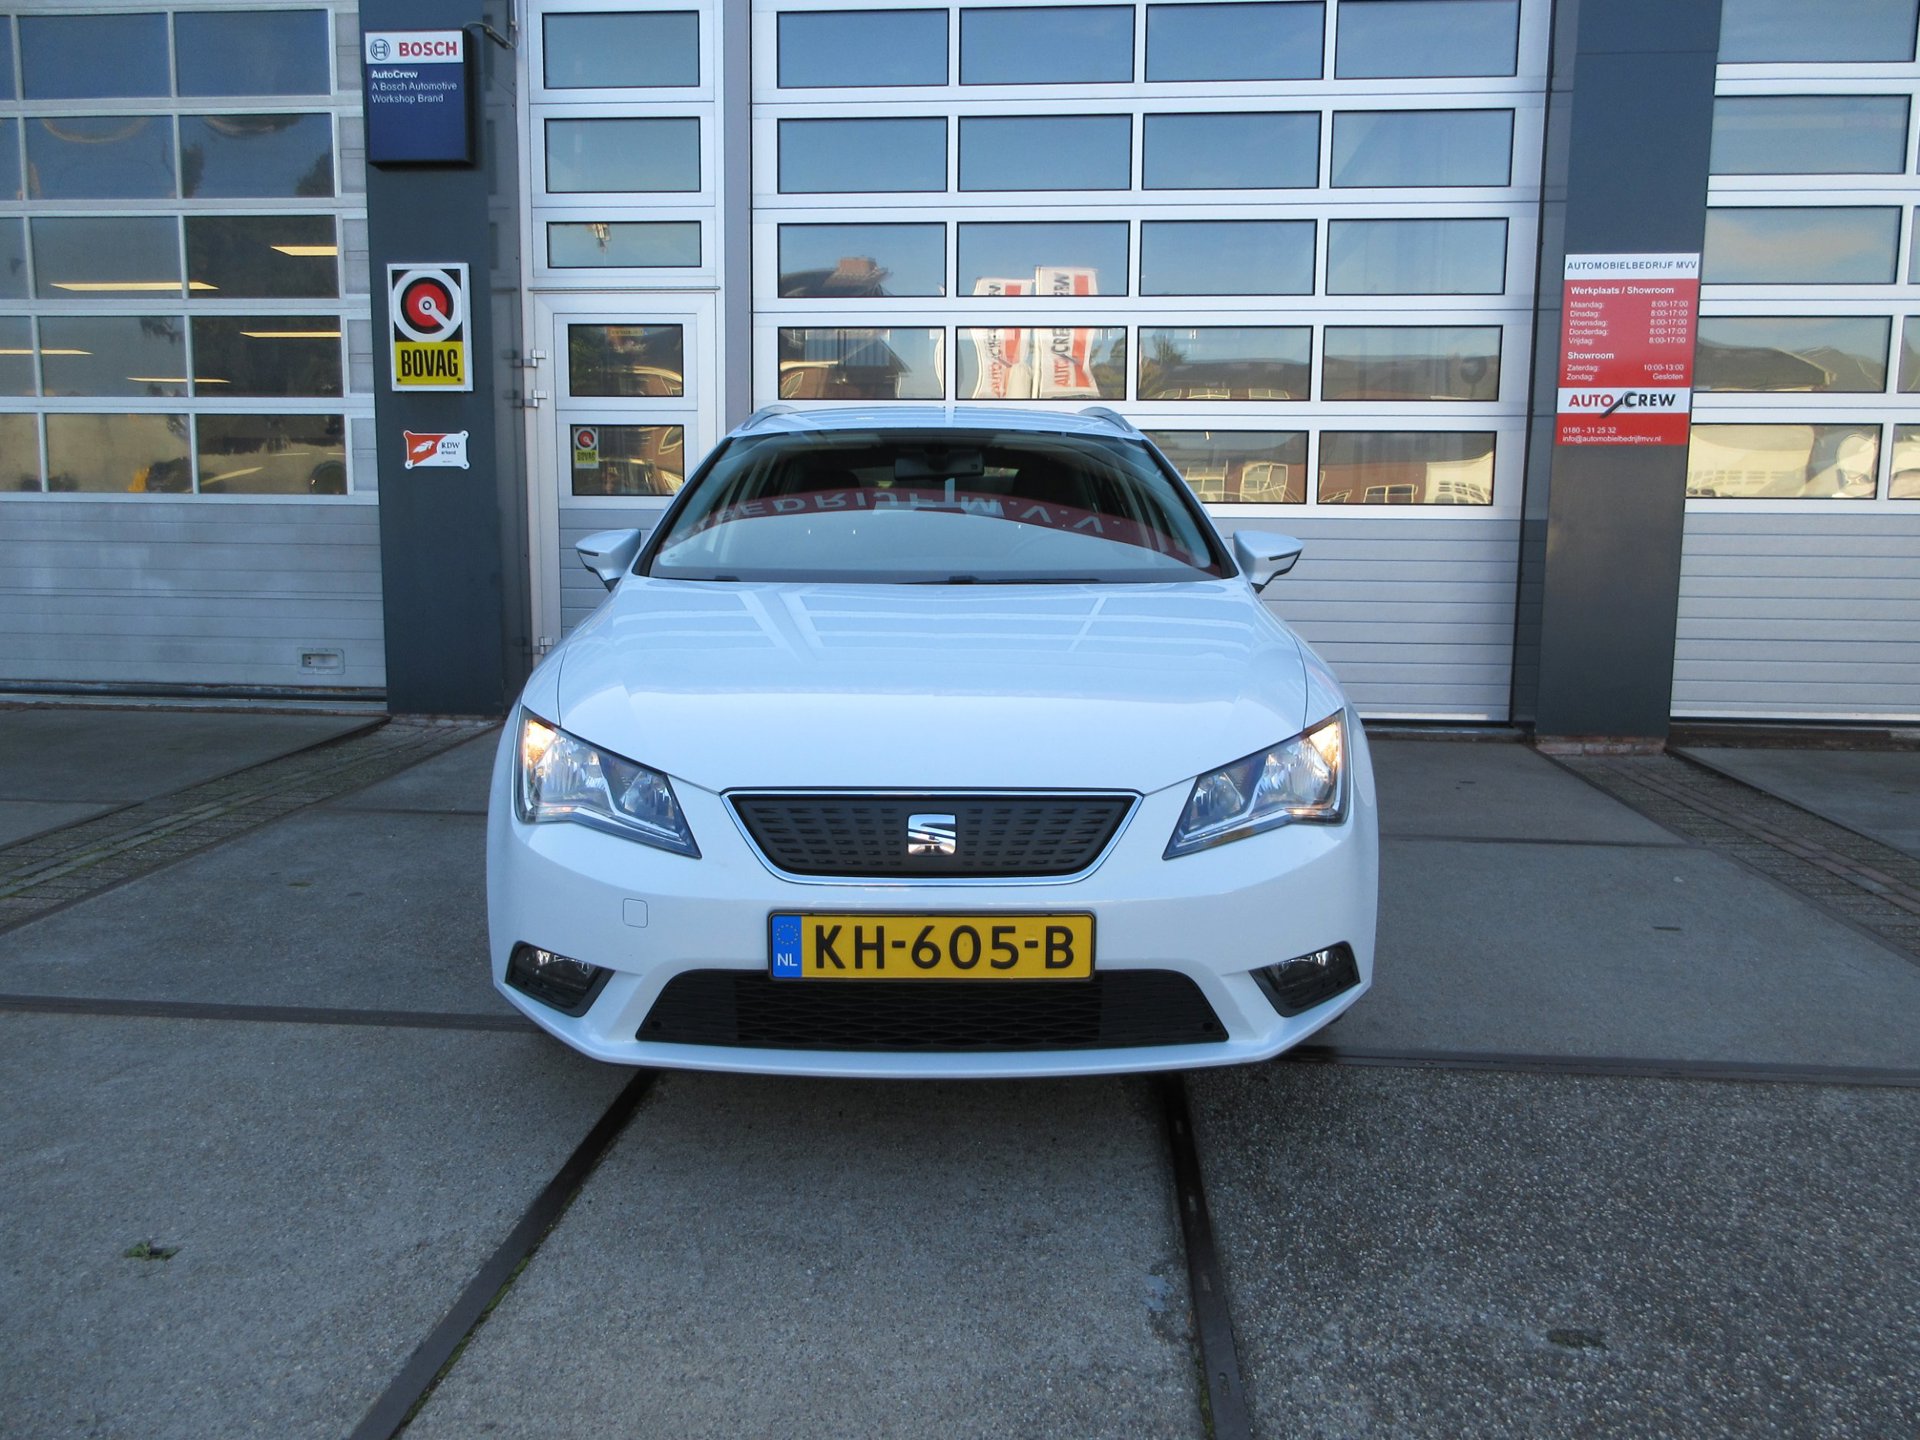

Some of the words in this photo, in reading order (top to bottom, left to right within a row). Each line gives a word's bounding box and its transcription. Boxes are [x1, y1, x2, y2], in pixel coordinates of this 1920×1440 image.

[399, 42, 457, 56] BOSCH
[371, 70, 418, 79] AutoCrew
[380, 82, 407, 91] Bosch
[409, 82, 457, 91] Automotive
[372, 94, 415, 104] Workshop
[417, 94, 444, 103] Brand
[1567, 260, 1673, 270] AUTOMOBIELBEDRIJF
[1676, 260, 1697, 269] MVV
[1571, 287, 1620, 296] Werkplaats
[1626, 286, 1675, 294] Showroom
[1567, 352, 1614, 360] Showroom
[401, 348, 458, 378] BOVAG
[1568, 394, 1614, 407] AUTO
[1623, 392, 1676, 408] CREW
[441, 441, 460, 449] RDW
[777, 953, 798, 967] NL
[815, 925, 1074, 969] KH-605-B
